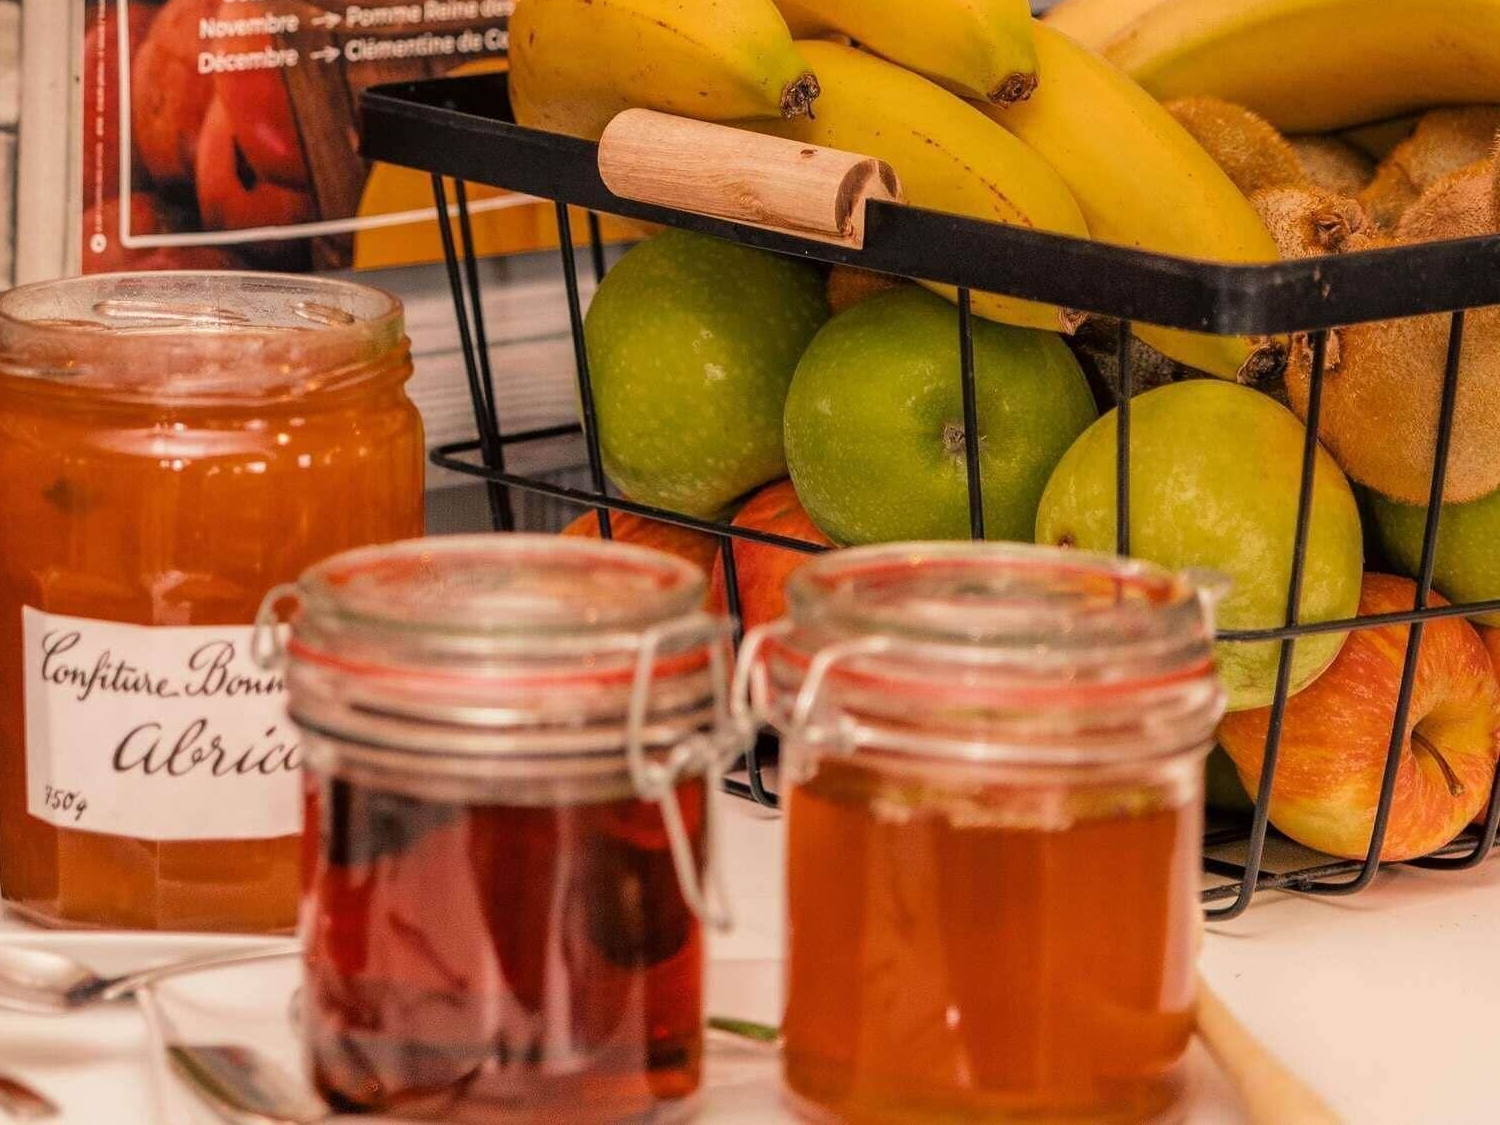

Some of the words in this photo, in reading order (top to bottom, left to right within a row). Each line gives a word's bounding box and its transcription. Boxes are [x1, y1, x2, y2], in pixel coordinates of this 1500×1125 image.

[199, 11, 299, 39] Novembre
[346, 4, 422, 28] Pomme
[197, 44, 299, 74] Décembre
[344, 32, 455, 62] Clémentine
[456, 27, 484, 53] de
[41, 630, 180, 701] Confiture
[186, 641, 286, 697] Bonn
[113, 718, 303, 776] Abrico
